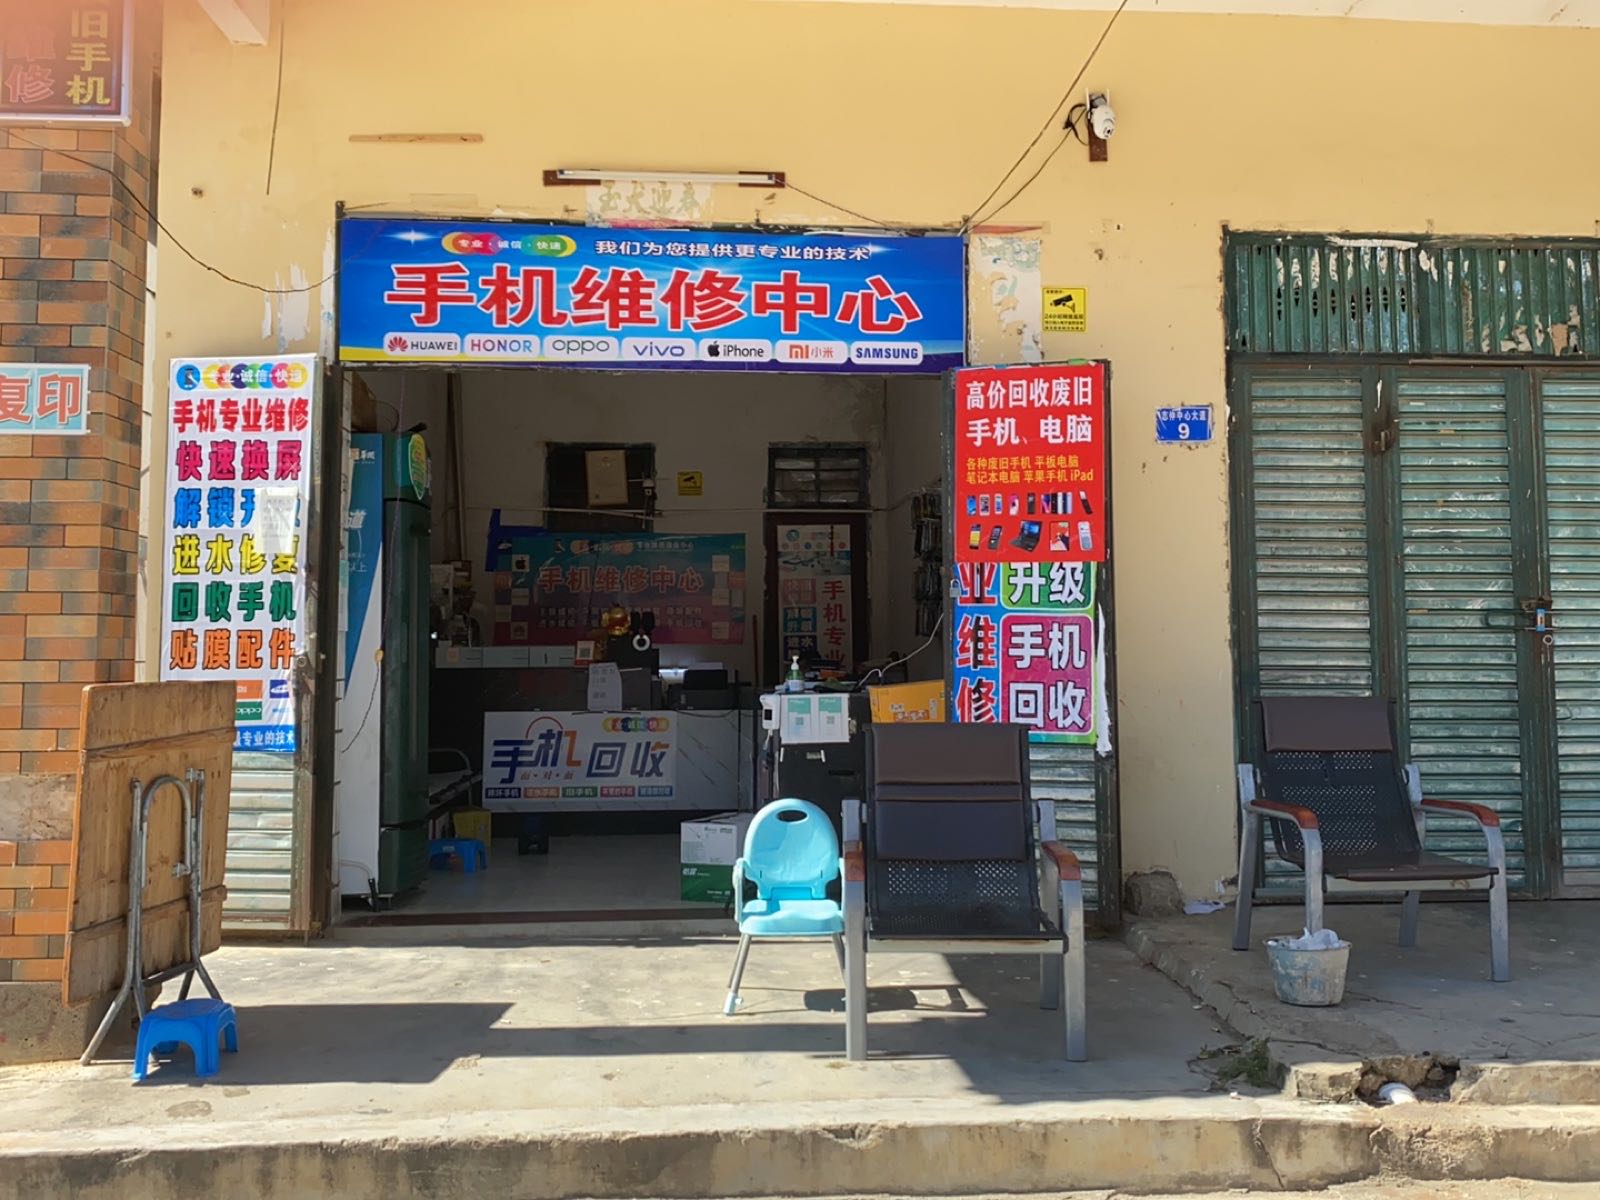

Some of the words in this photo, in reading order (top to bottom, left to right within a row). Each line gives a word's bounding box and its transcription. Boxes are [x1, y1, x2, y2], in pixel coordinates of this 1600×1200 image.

[595, 239, 869, 261] 我们为您提供更专业的技术
[384, 262, 923, 334] 手机维修中心
[411, 340, 458, 351] HUAWEI
[470, 339, 532, 352] HONOR
[723, 343, 764, 358] iPhone
[855, 347, 919, 360] SAMSUNG
[0, 373, 81, 424] 复印
[966, 376, 1093, 410] 高价回收废旧
[173, 397, 309, 433] 手机专业维修
[1178, 422, 1190, 439] 9
[175, 439, 302, 481] 快速换屏
[966, 457, 1032, 471] 各种废旧手机
[1035, 455, 1079, 469] 平板电脑
[966, 470, 1020, 484] 笔记本电脑
[1024, 469, 1068, 483] 苹果手机
[1070, 469, 1094, 481] iPad
[173, 487, 300, 529] 解锁开
[536, 565, 705, 593] 手机维修中心
[1008, 562, 1086, 604] 升级
[171, 580, 297, 622] 回收手机
[169, 628, 296, 670] 贴膜配件
[1008, 623, 1087, 669] 手机
[1008, 681, 1087, 729] 回收
[490, 728, 670, 784] 手机回收
